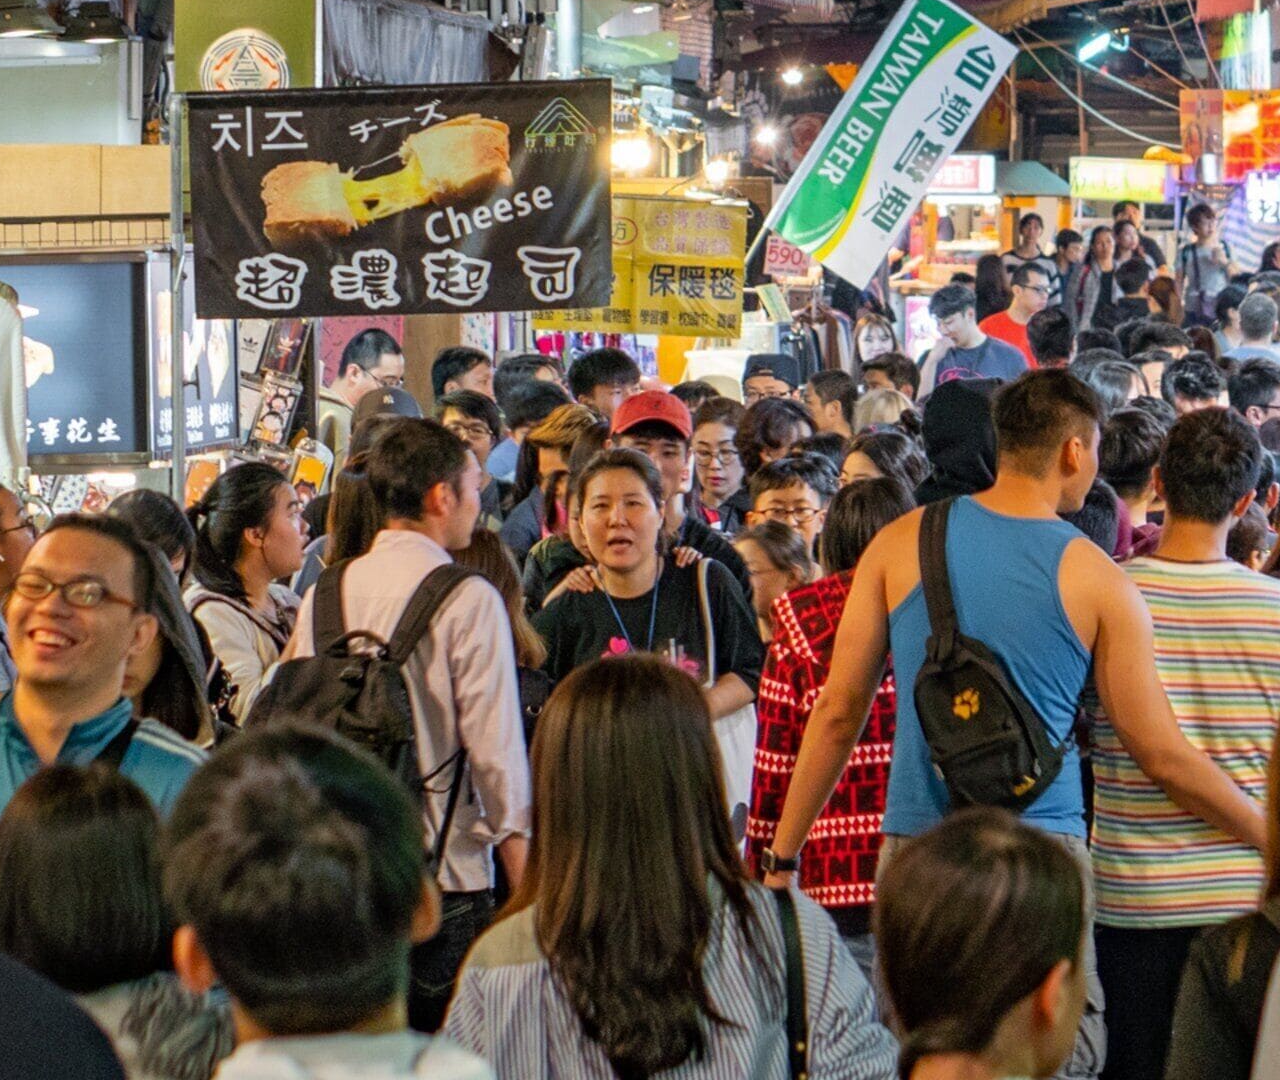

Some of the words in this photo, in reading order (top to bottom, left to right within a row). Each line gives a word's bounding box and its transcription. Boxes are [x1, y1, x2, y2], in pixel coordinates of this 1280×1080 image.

[859, 10, 945, 120] TAIWAN
[210, 105, 309, 157] 치즈
[349, 99, 448, 143] チーズ
[862, 44, 997, 233] 台灣啤酒
[816, 117, 874, 186] BEER
[425, 185, 554, 245] Cheese
[234, 245, 582, 311] 超濃起司
[647, 262, 737, 300] 保暖毯
[767, 244, 804, 266] 590
